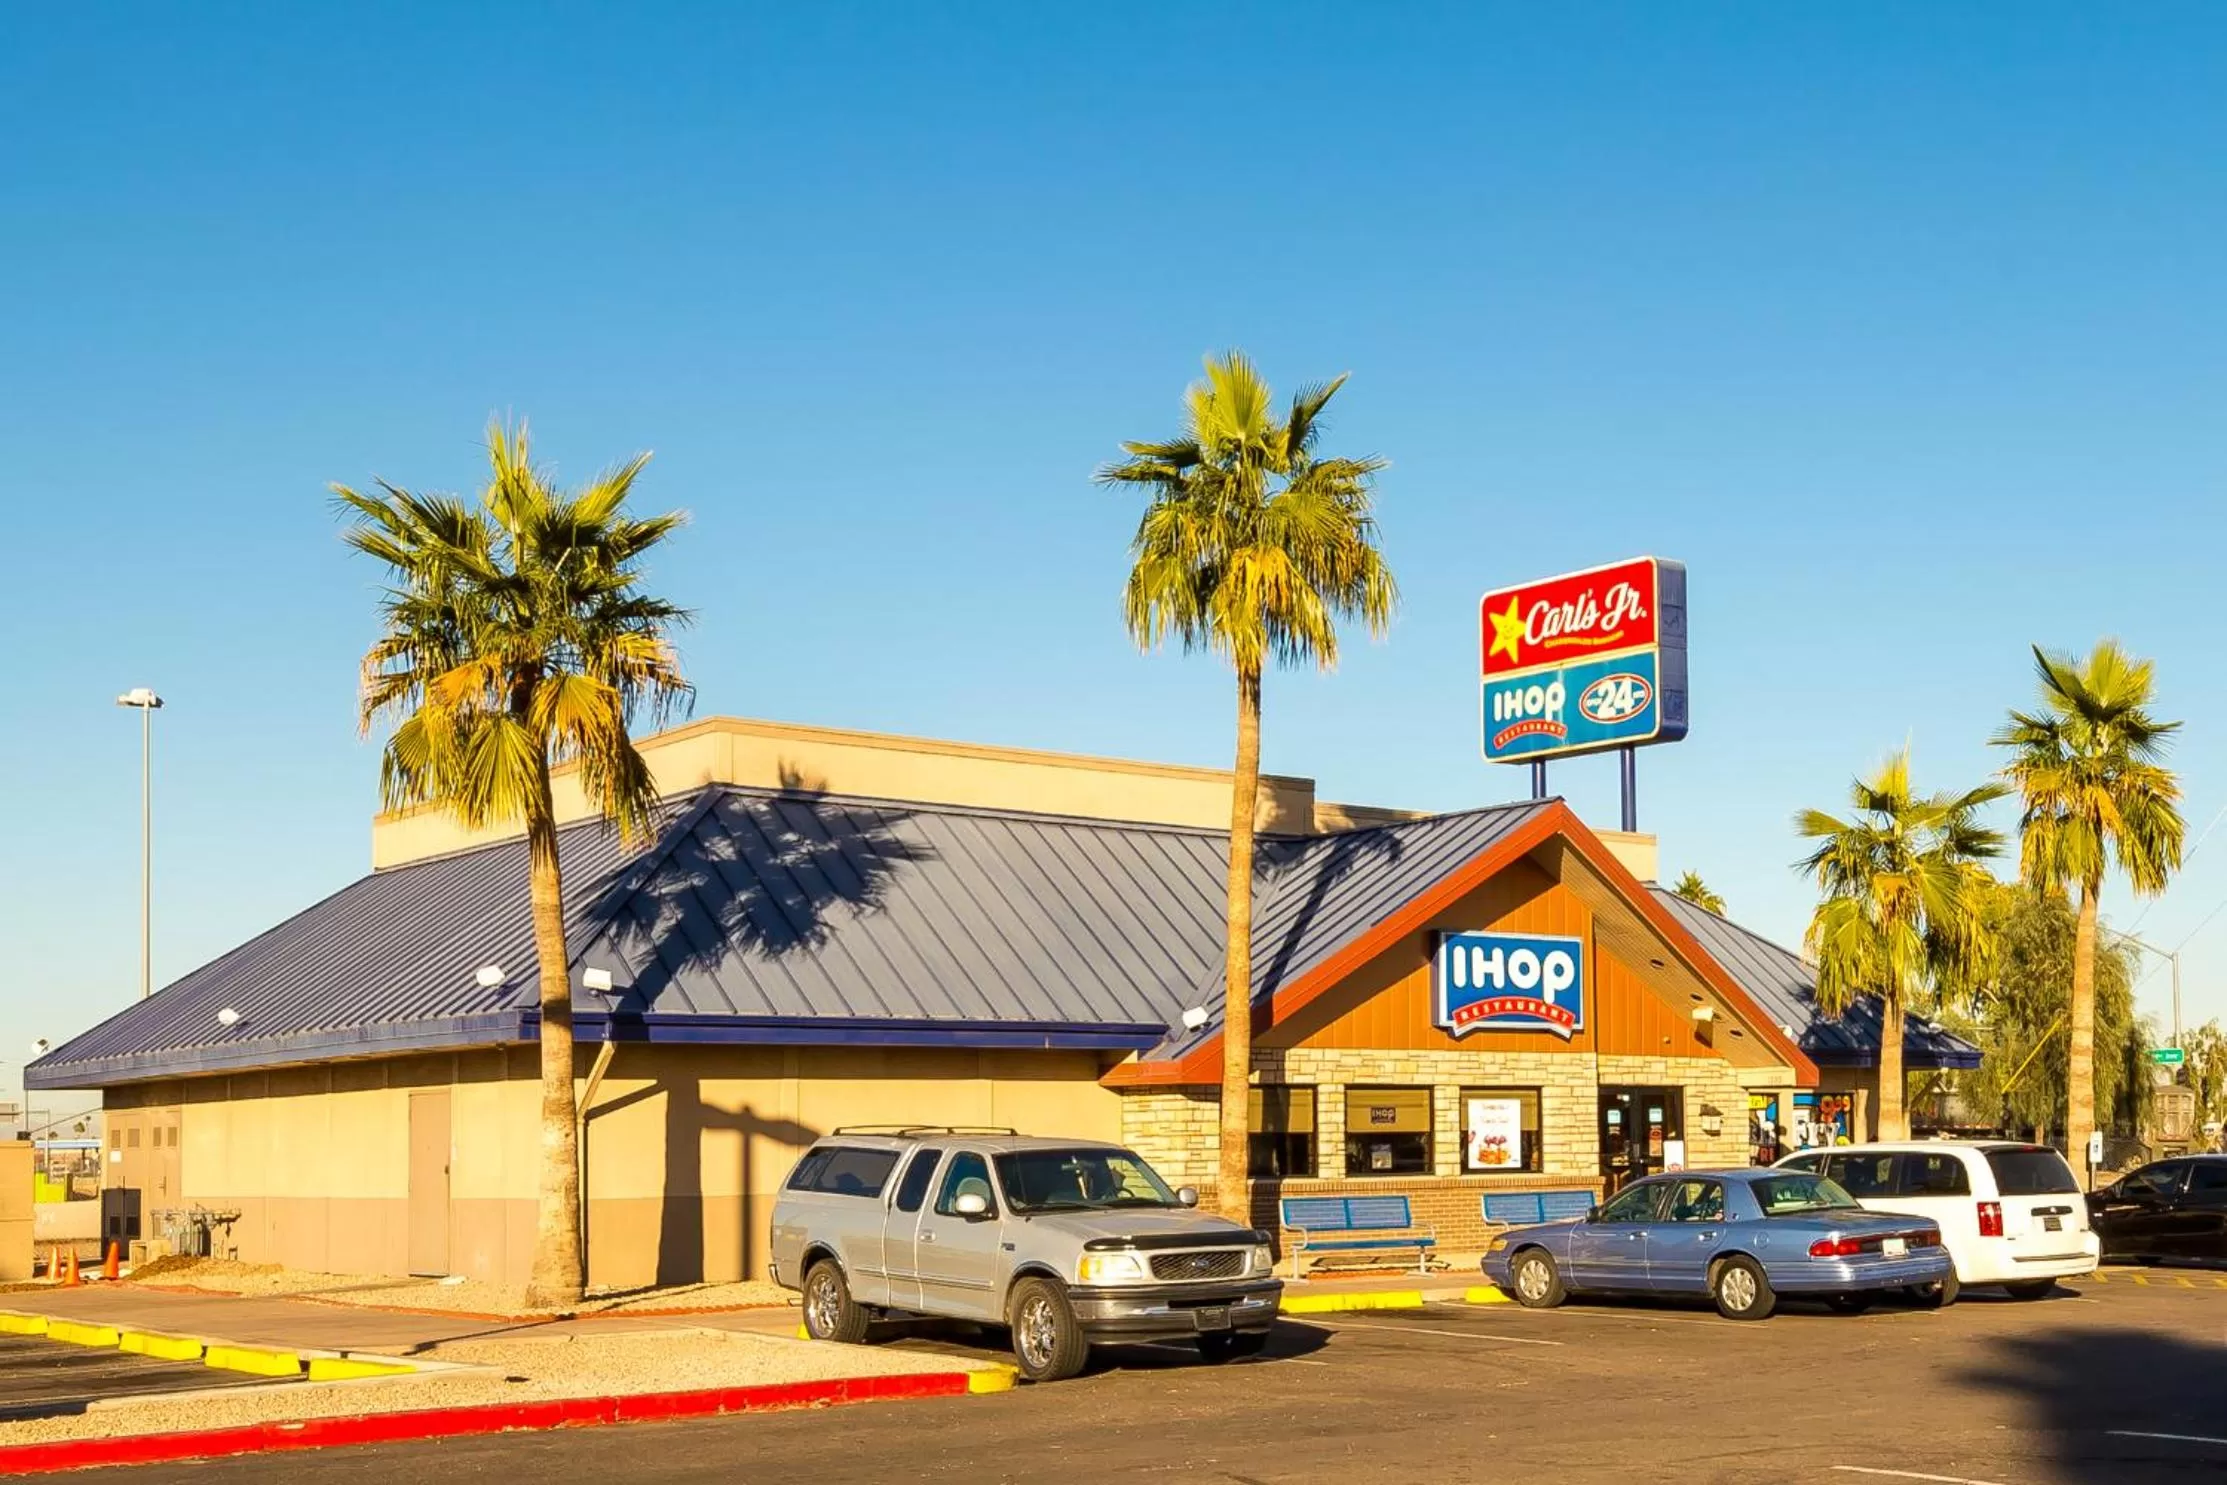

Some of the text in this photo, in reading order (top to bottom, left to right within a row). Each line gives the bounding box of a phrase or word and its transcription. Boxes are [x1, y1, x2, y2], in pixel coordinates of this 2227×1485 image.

[1524, 582, 1647, 646] Carl's Jr.
[1494, 682, 1566, 722] IHOP
[1452, 945, 1575, 1004] IHOP
[1460, 1000, 1569, 1021] RESTAURANT
